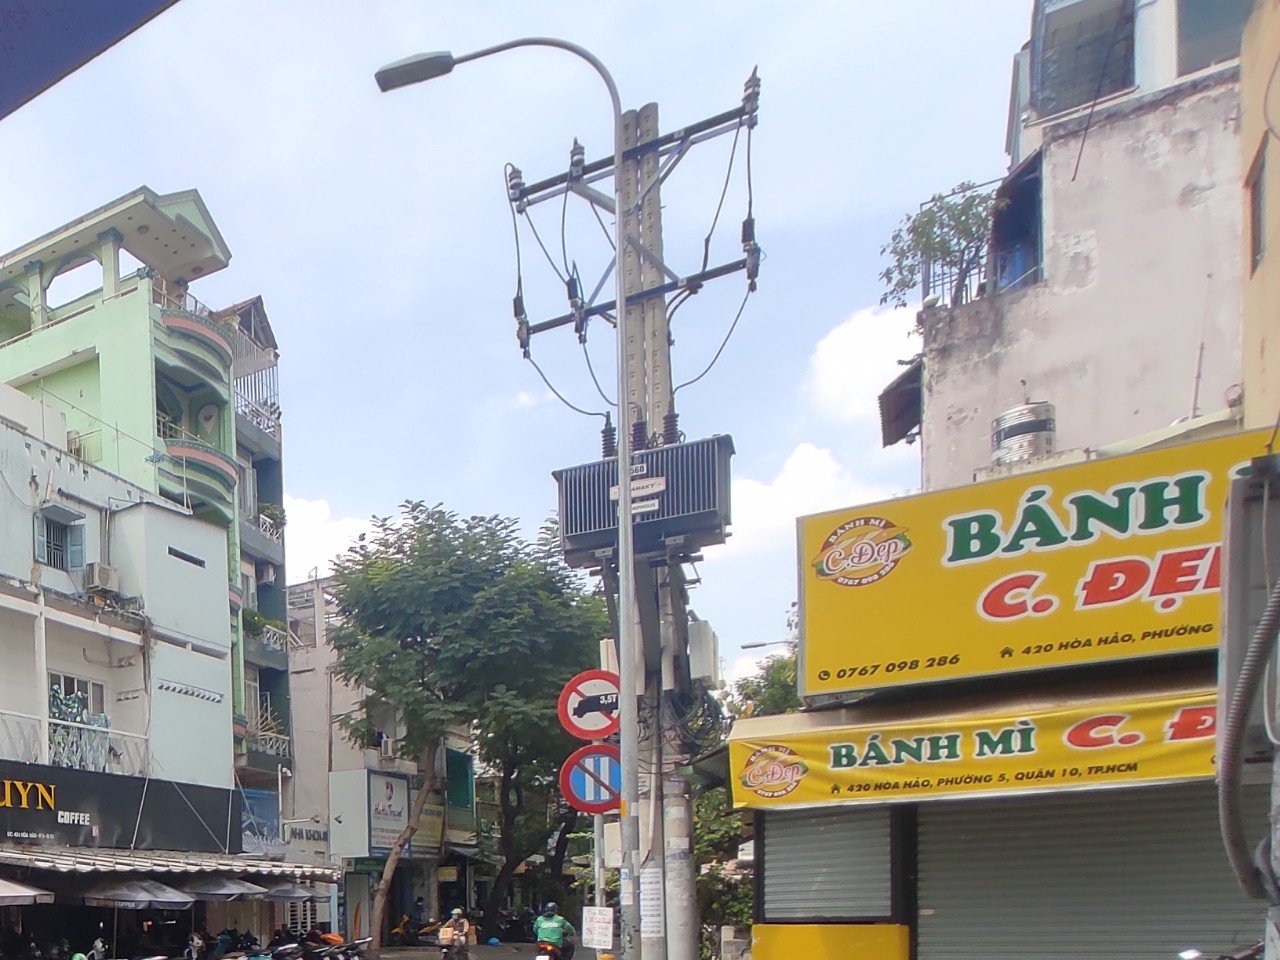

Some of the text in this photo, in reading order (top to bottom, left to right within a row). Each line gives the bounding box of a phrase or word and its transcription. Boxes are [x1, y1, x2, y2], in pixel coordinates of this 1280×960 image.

[829, 519, 865, 543] BÁNH
[947, 475, 1205, 562] BÁNH
[851, 540, 899, 565] Đẹp
[837, 577, 859, 585] 0767
[861, 574, 879, 584] 098
[982, 574, 1054, 618] C.
[1021, 623, 1214, 655] 420 HÒA HẢO, PHƯỜNG
[836, 654, 961, 679] 0767 098 286
[600, 694, 617, 704] 3,5T
[830, 734, 960, 768] BÁNH
[976, 720, 1035, 757] MÌ
[847, 784, 870, 793] 420
[903, 776, 933, 789] HẢO,
[937, 773, 993, 786] PHƯỜNG
[998, 773, 1009, 784] 5,
[1014, 769, 1055, 783] QUẬN
[1062, 767, 1082, 777] 10,
[1087, 762, 1138, 775] TP.HCM
[57, 810, 90, 826] COFFEE
